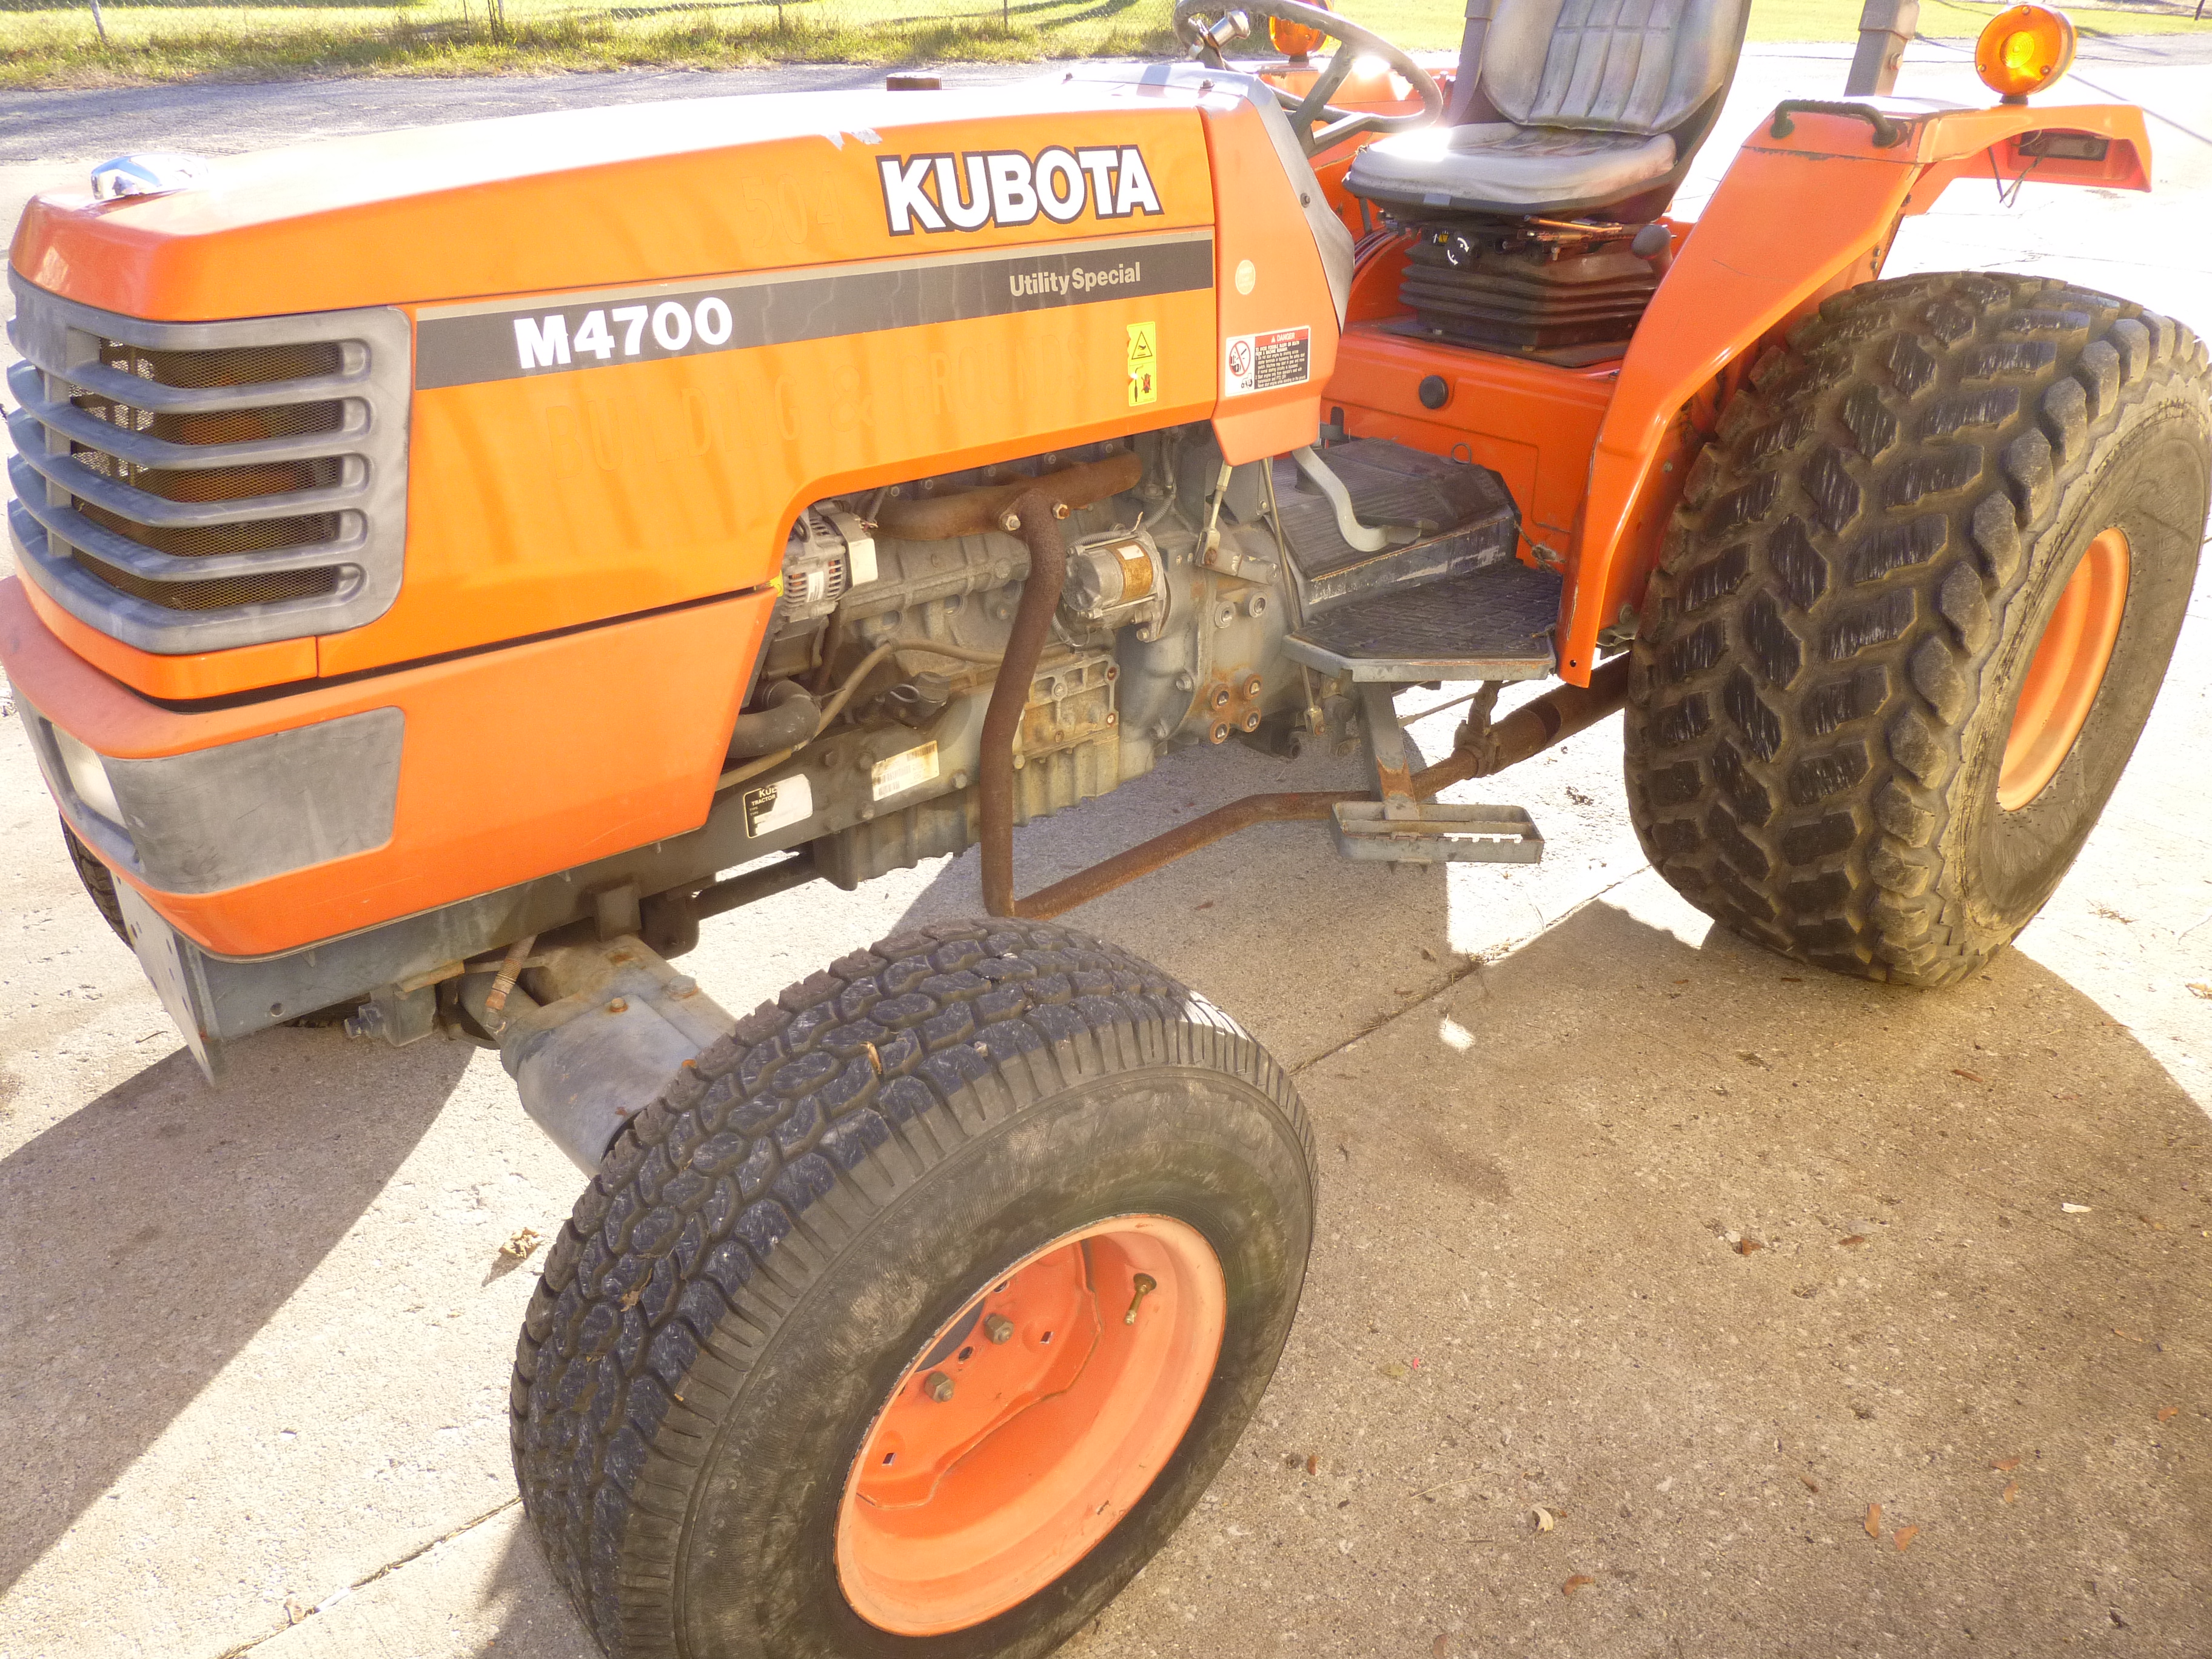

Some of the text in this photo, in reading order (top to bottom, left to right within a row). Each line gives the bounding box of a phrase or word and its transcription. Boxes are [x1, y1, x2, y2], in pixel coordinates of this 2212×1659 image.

[877, 144, 1164, 236] KUBOTA
[1010, 262, 1141, 297] Utility Special
[514, 297, 733, 369] M4700
[1277, 332, 1295, 342] DANGER
[752, 794, 776, 806] TRACTOR
